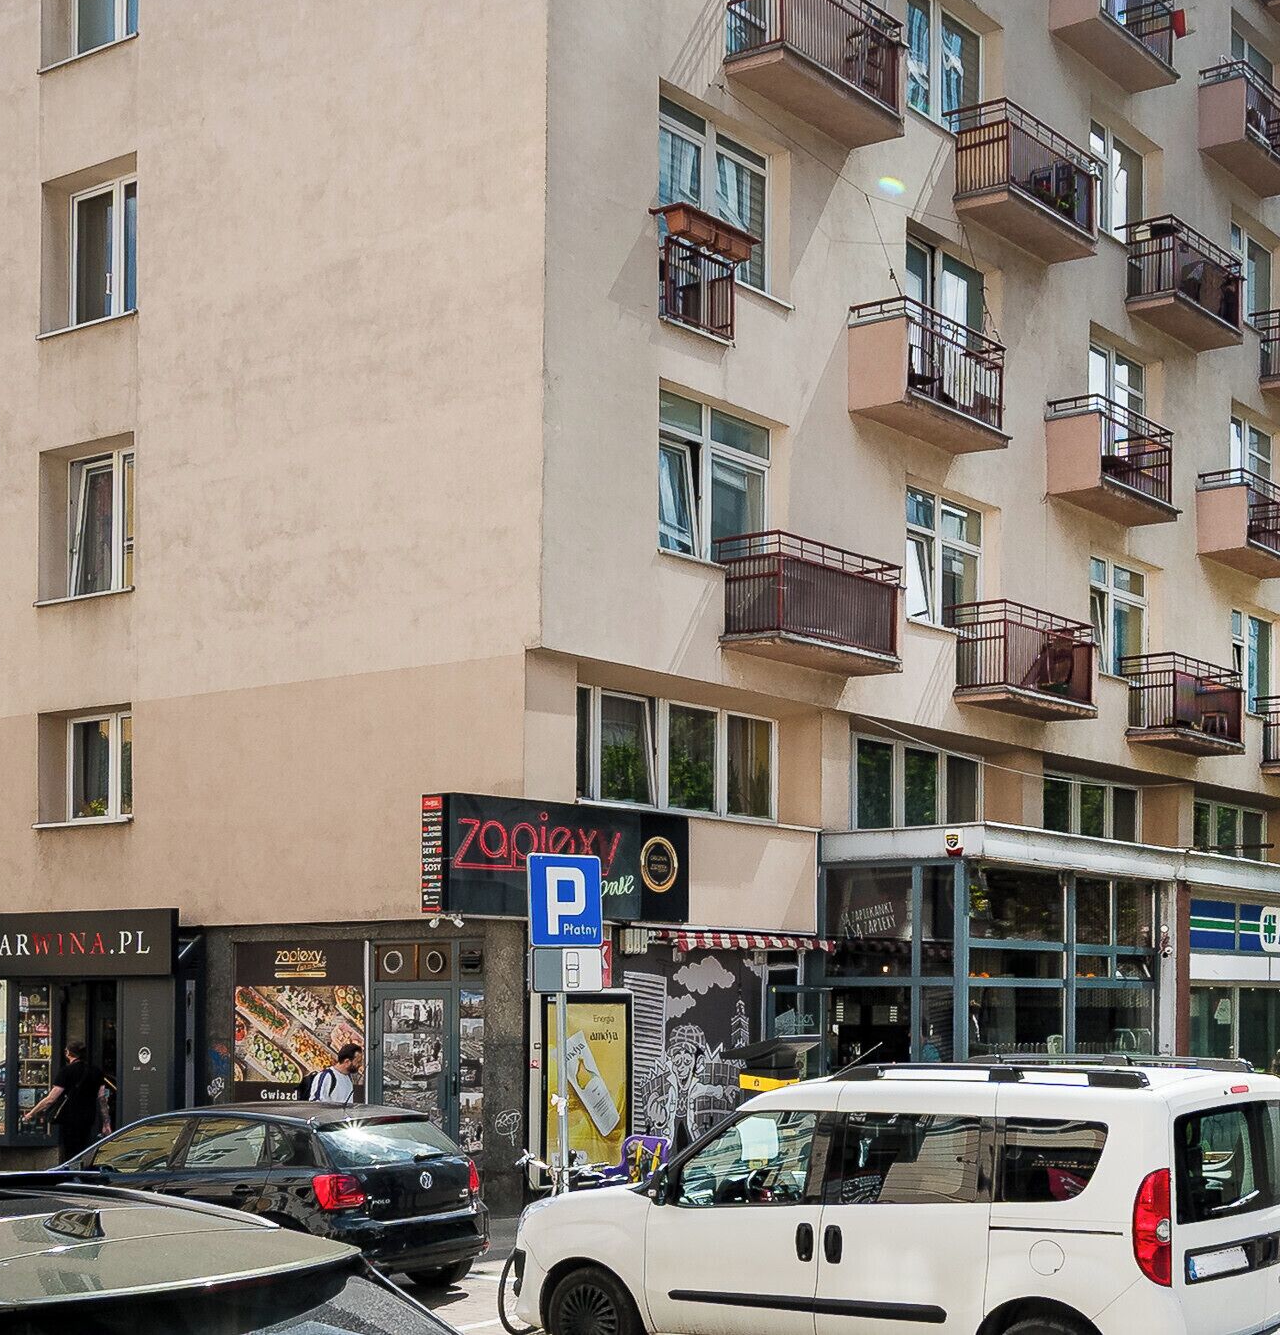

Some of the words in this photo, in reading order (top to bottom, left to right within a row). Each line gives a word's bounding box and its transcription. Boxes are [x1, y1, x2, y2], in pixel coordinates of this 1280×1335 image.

[424, 863, 441, 871] SOSY
[546, 866, 586, 935] P
[563, 923, 598, 938] Płatny
